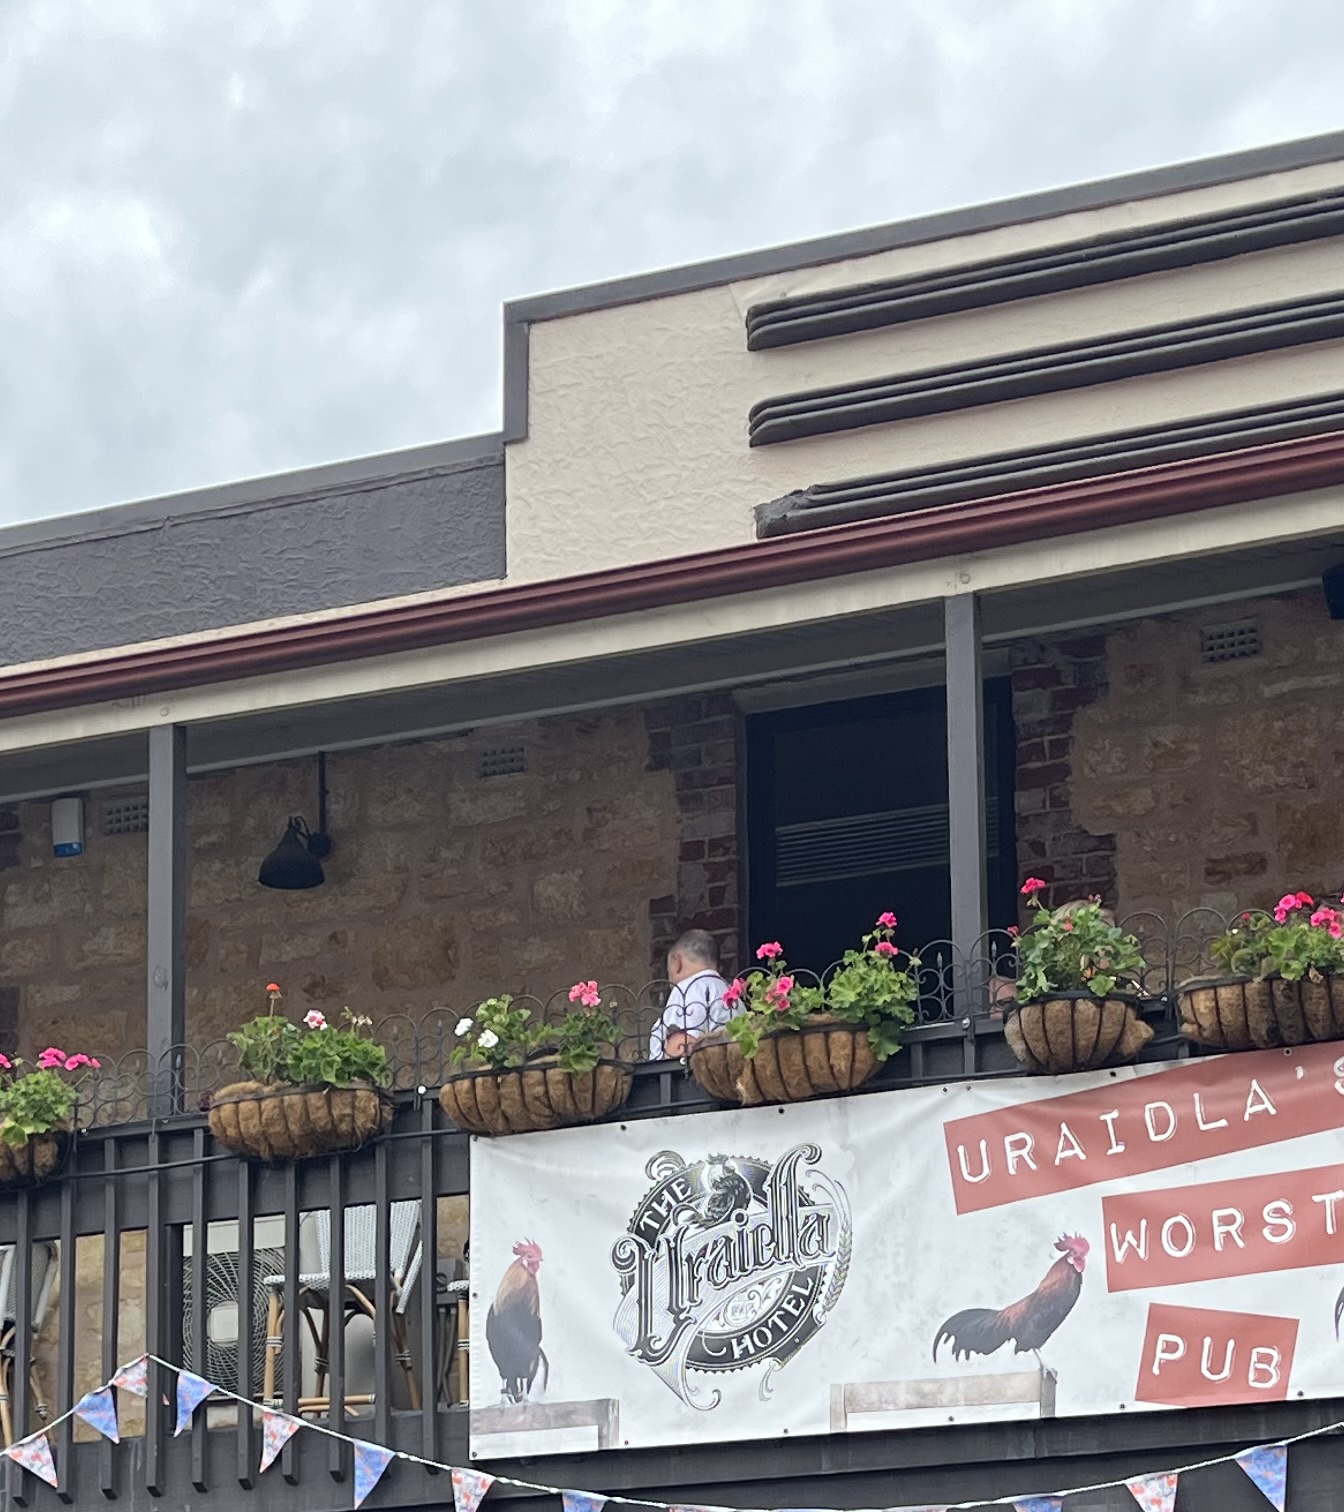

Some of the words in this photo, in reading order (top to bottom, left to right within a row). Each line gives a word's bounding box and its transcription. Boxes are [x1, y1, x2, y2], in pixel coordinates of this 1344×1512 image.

[640, 1177, 695, 1236] THE
[611, 1143, 836, 1366] Uraidla
[730, 1277, 815, 1360] HOTEL
[1151, 1332, 1284, 1391] PUB
